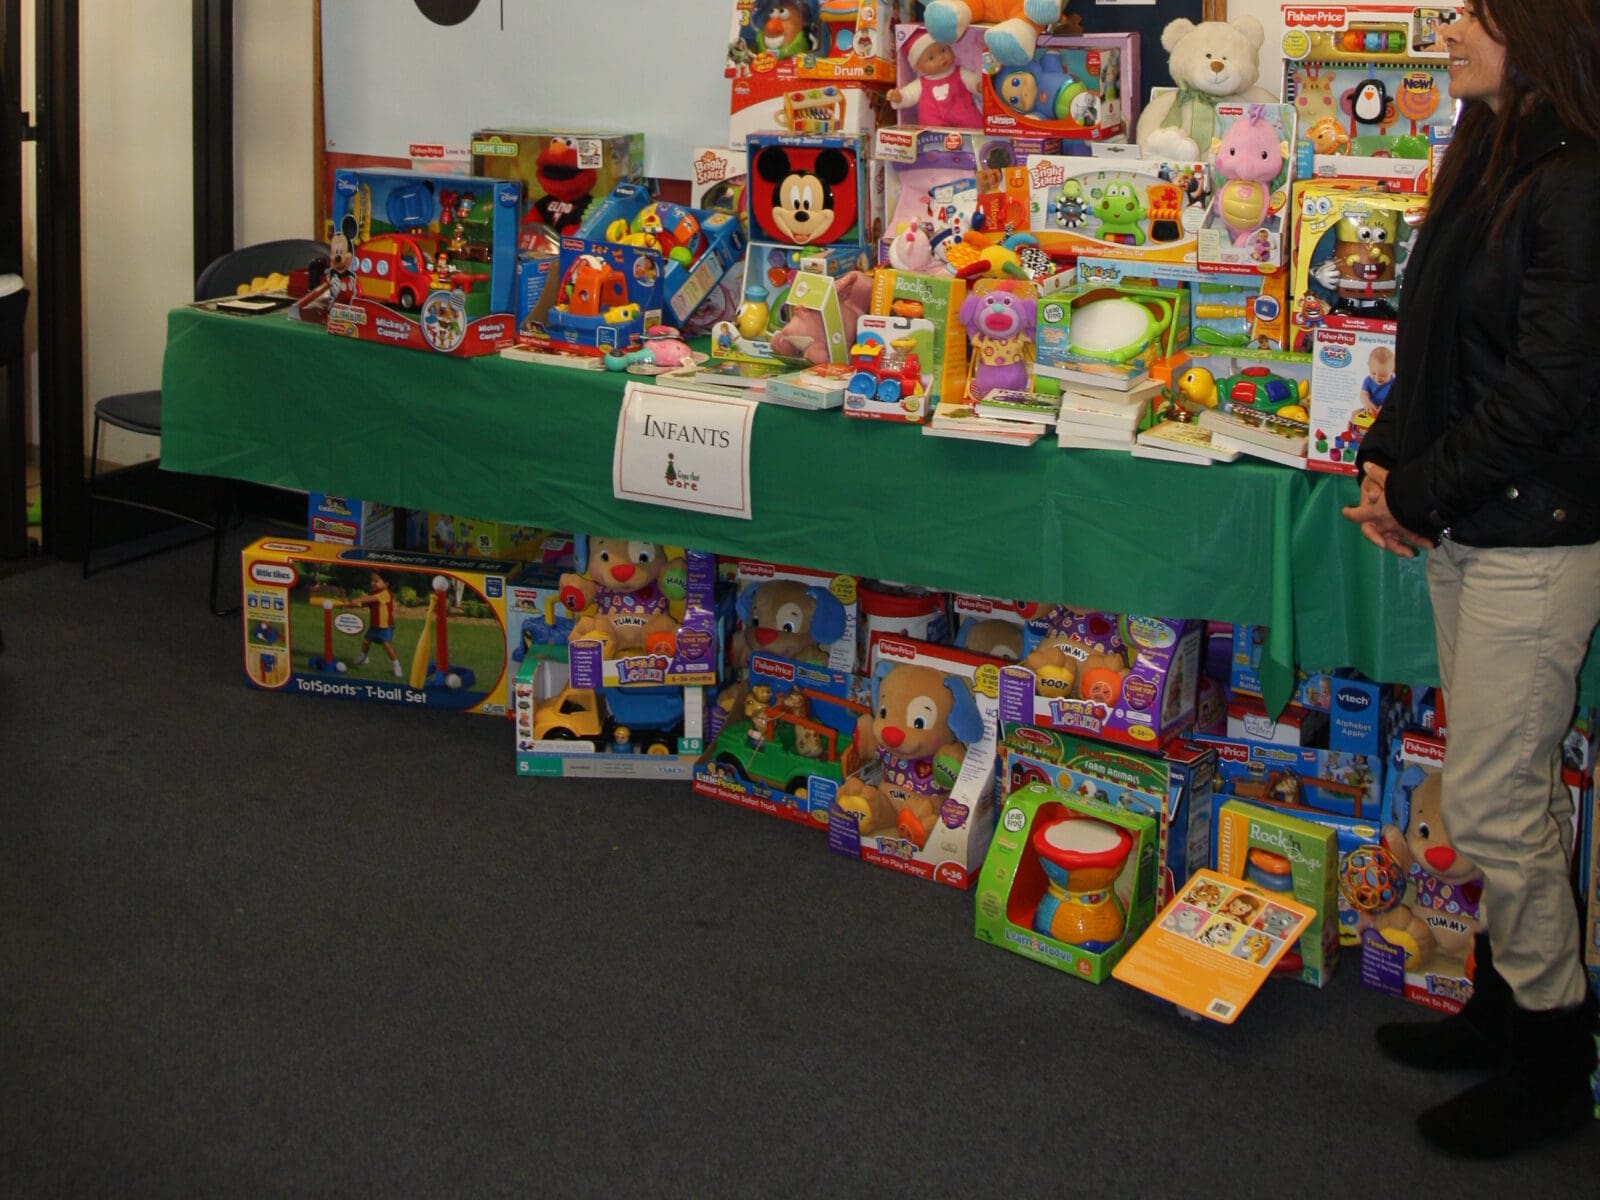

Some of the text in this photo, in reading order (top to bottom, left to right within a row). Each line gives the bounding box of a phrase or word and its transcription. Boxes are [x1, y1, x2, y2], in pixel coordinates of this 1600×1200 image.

[1287, 11, 1344, 22] Fisher-Price
[833, 65, 864, 77] Drum
[1403, 78, 1434, 90] New!
[695, 158, 727, 174] Bright
[1030, 165, 1064, 180] Bright
[697, 169, 725, 185] Starts
[1033, 176, 1063, 189] Starts
[896, 277, 922, 293] Rock
[376, 318, 411, 333] Mickey's
[377, 328, 409, 341] Camper
[1318, 331, 1355, 343] Fisher-Price
[642, 414, 730, 449] INFANTS
[666, 477, 698, 491] Care
[479, 536, 490, 547] 30
[256, 568, 291, 580] little tikes
[958, 599, 991, 611] Fisher-Price
[613, 616, 649, 627] TUMMY
[1029, 621, 1049, 630] vtec
[880, 643, 915, 656] Fisher-Price
[754, 660, 793, 676] Fisher-Price
[1040, 678, 1068, 689] FOOT
[365, 685, 401, 702] T-ball
[405, 689, 427, 704] Set
[1337, 693, 1369, 706] vtech
[1052, 702, 1100, 732] Learn
[1336, 718, 1372, 732] Alphabet
[1341, 726, 1365, 738] Apple
[683, 740, 699, 749] 18
[1085, 760, 1141, 784] FARM ANIMALS
[760, 799, 777, 812] Truck
[1007, 812, 1023, 822] Leap
[1007, 819, 1022, 829] Frog
[1250, 823, 1287, 847] Rock
[942, 868, 962, 880] 6-36
[1426, 916, 1468, 933] TUMMY
[1005, 928, 1033, 947] Learn
[1038, 939, 1072, 962] Groove
[1411, 991, 1430, 1003] Love
[1432, 997, 1442, 1008] to
